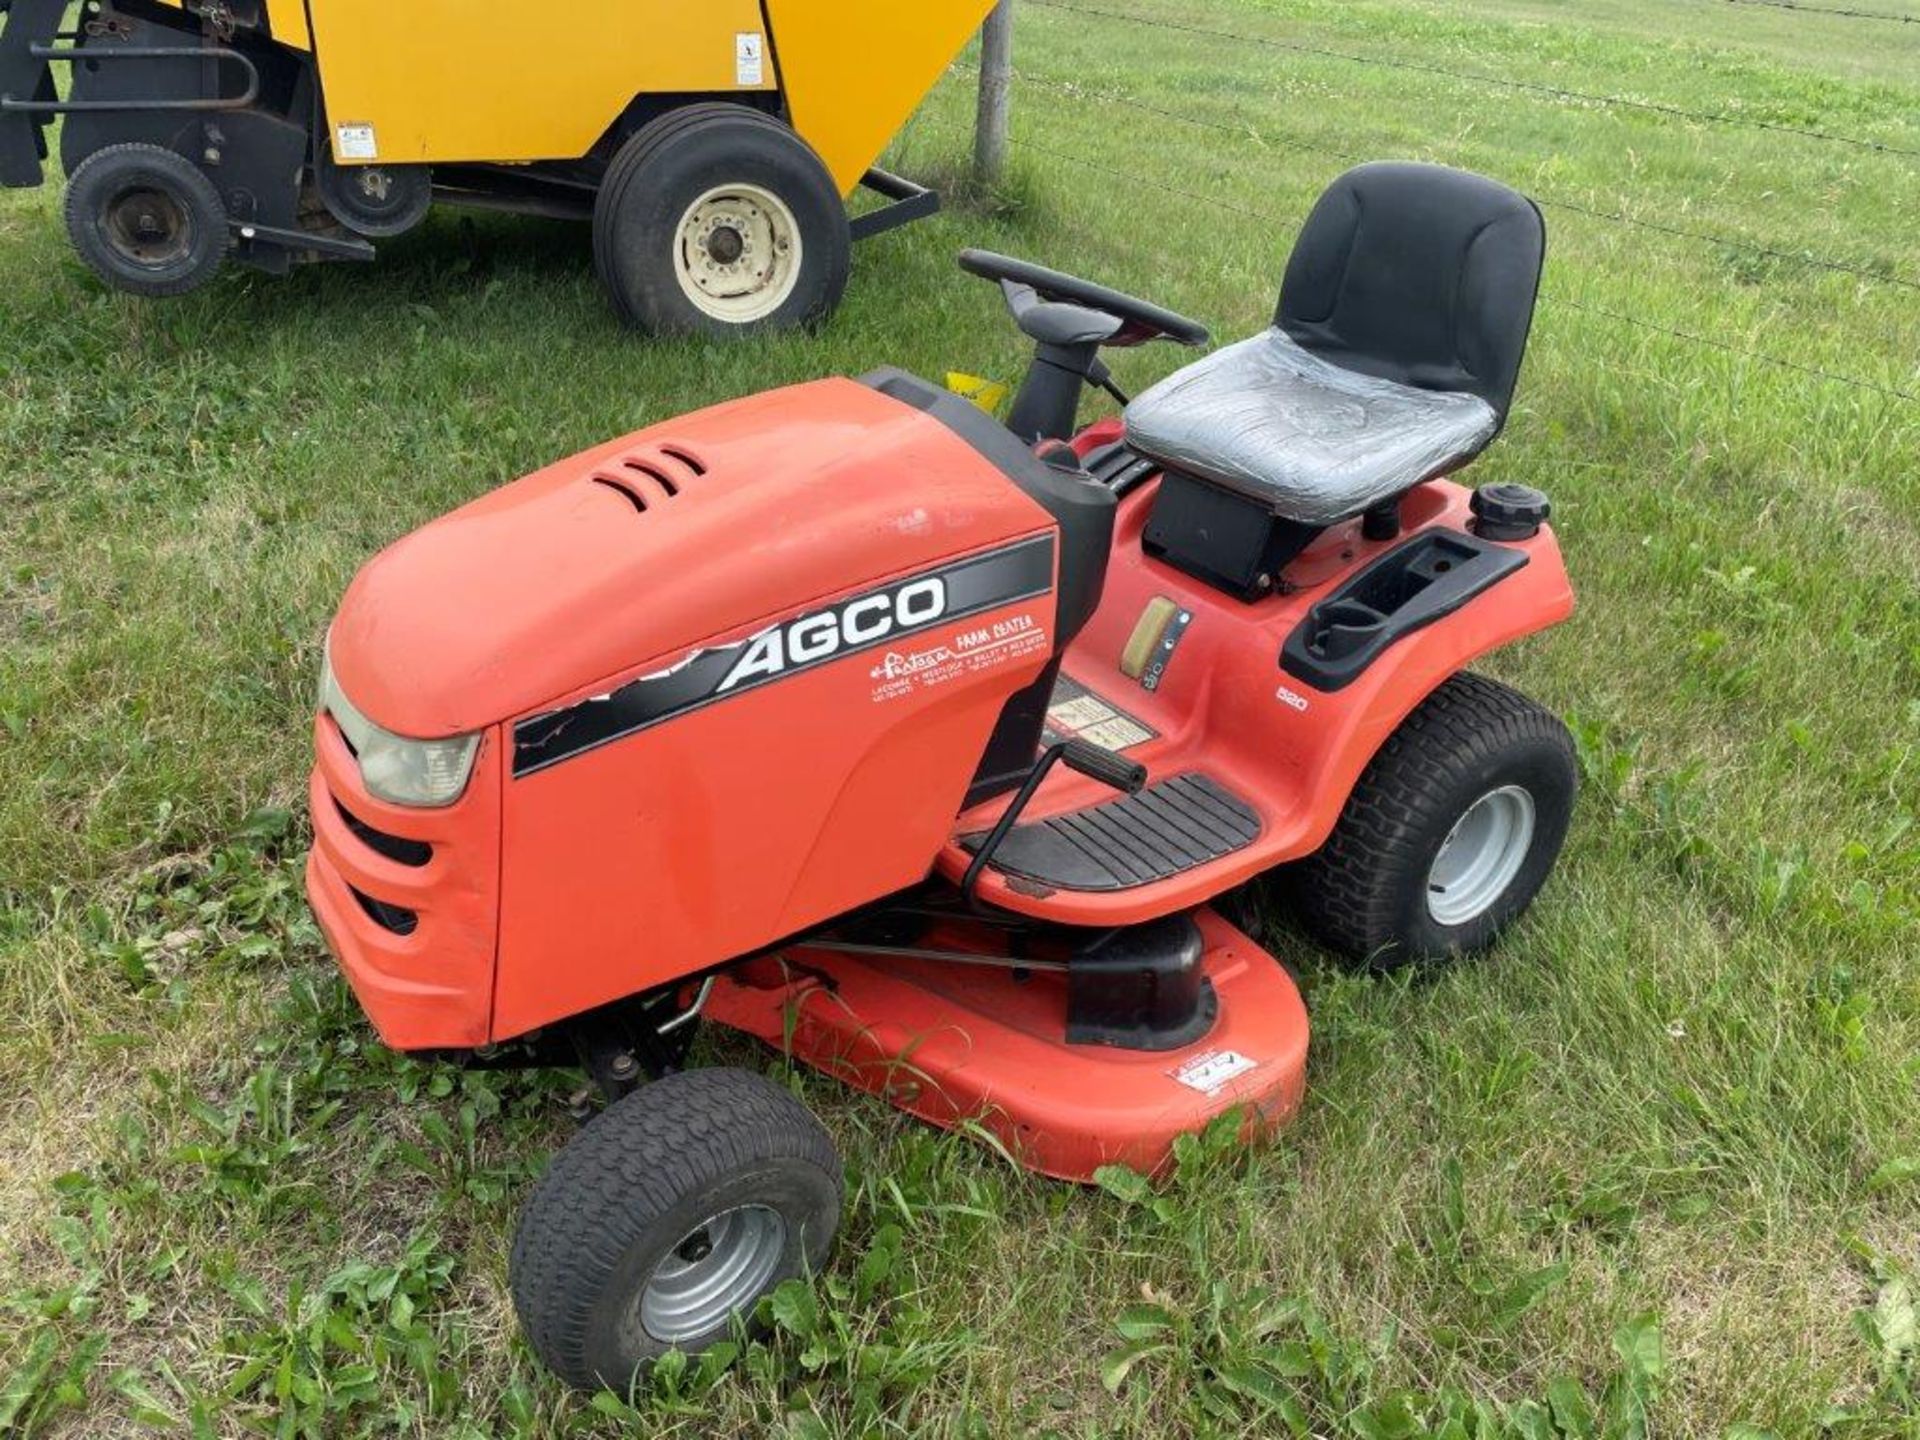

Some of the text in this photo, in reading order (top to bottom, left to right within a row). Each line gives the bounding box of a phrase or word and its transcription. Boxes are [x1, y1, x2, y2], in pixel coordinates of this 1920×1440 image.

[716, 577, 946, 694] AGCO
[956, 629, 991, 651] FARM
[1276, 685, 1308, 711] 520
